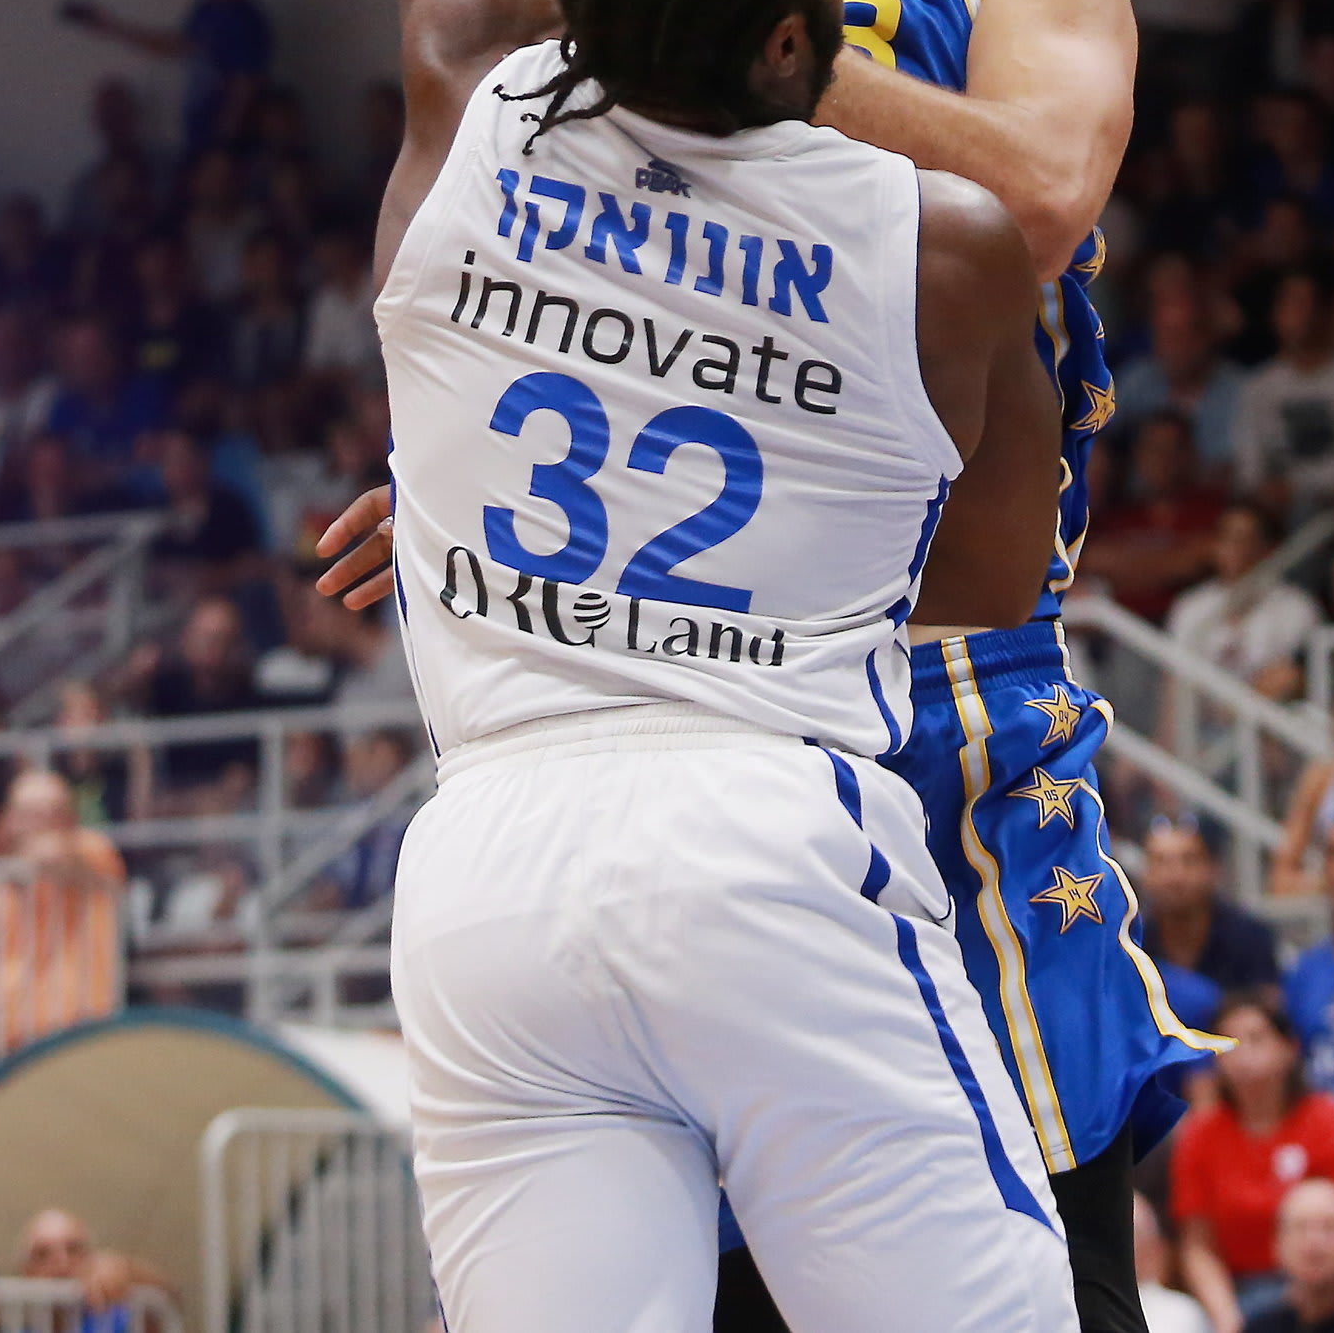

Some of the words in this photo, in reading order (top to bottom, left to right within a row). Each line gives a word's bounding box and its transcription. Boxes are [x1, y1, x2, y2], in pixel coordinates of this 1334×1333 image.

[495, 167, 834, 324] אונואקו
[451, 249, 843, 415] innovate
[482, 371, 764, 614] 32
